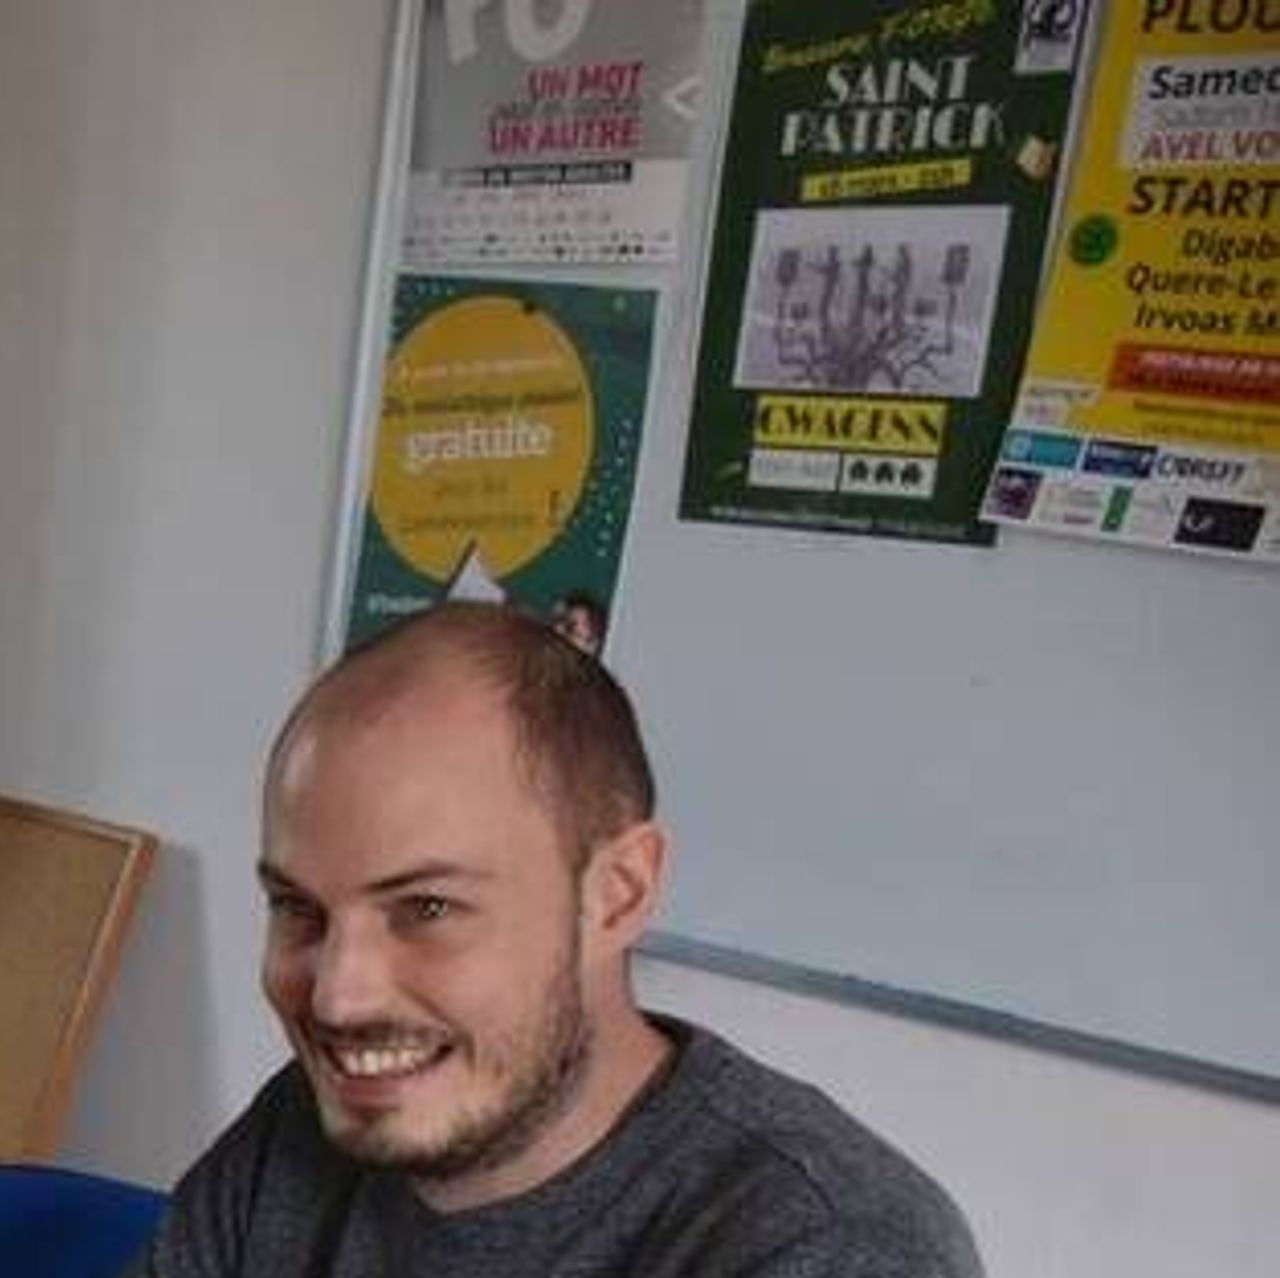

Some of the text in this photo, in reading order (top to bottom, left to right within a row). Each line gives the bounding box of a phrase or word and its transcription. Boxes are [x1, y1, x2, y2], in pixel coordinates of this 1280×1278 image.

[528, 61, 643, 101] UN MOT
[823, 54, 974, 107] SAINT
[489, 117, 643, 152] UN AUTRE
[781, 101, 1006, 157] PATRICK
[1140, 131, 1222, 161] AVEL
[404, 414, 555, 476] gratuite
